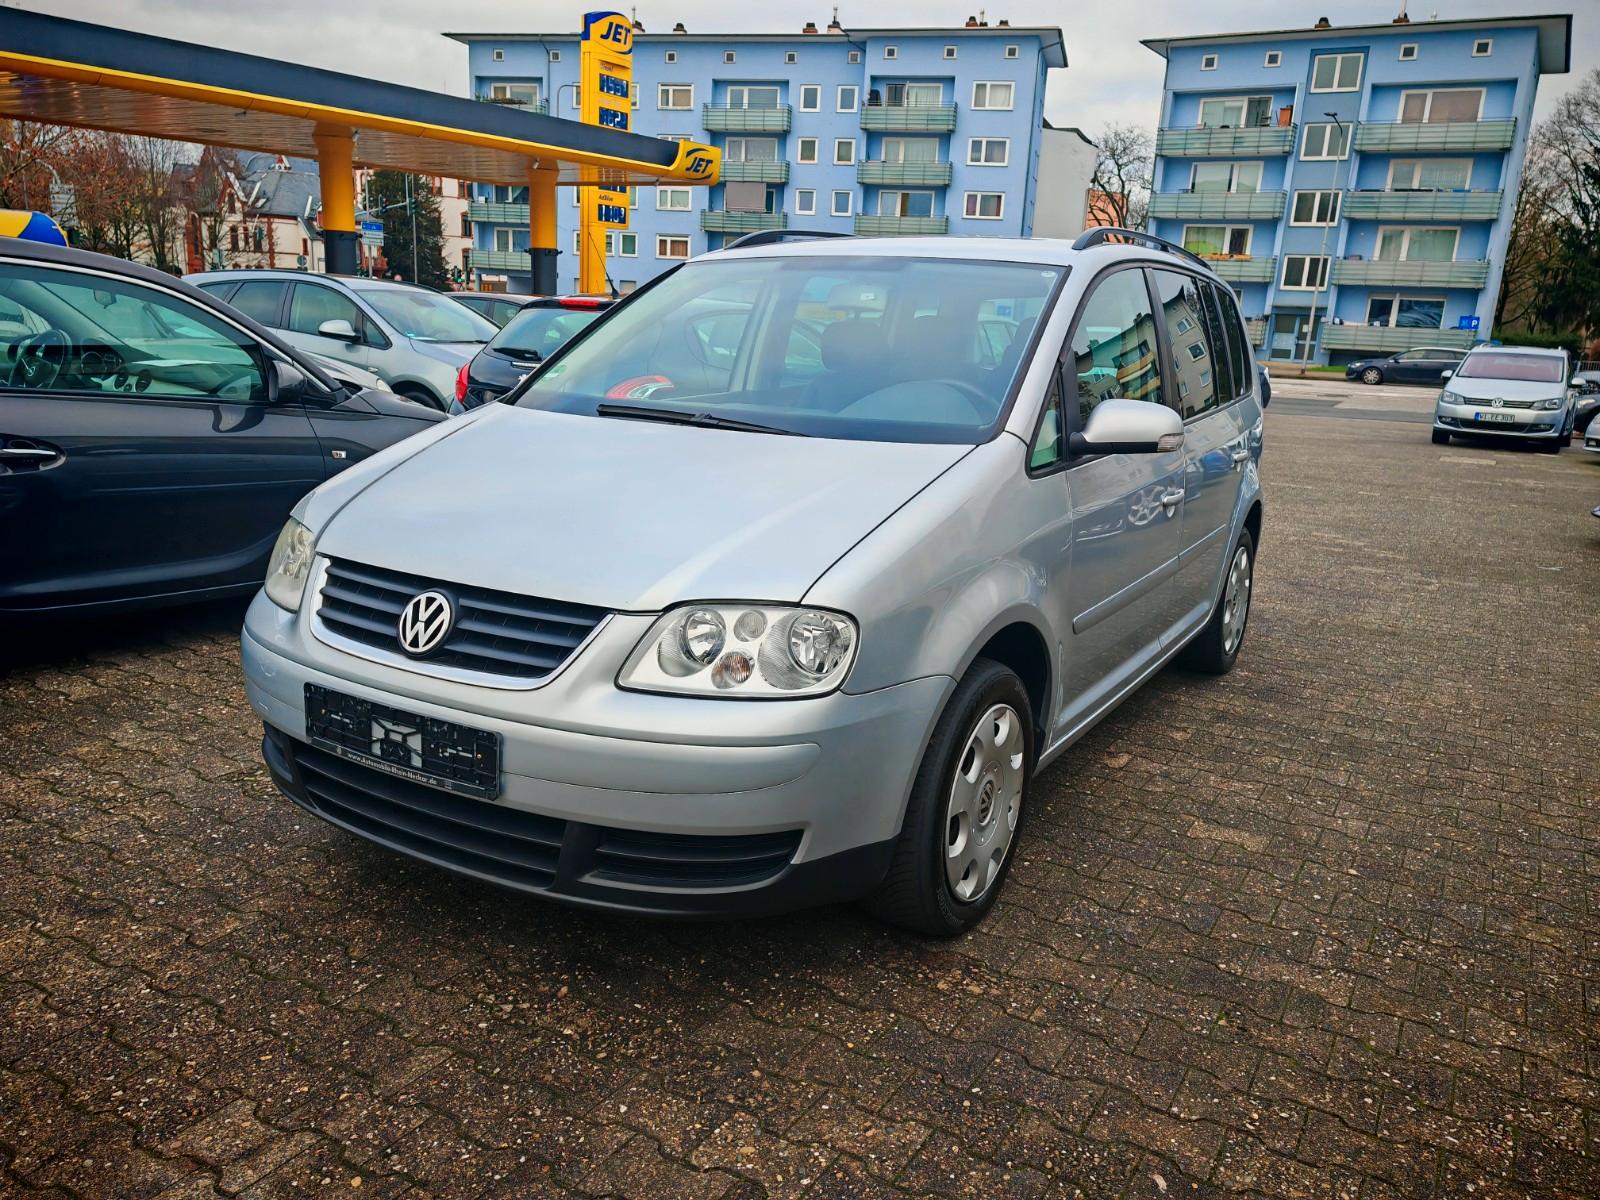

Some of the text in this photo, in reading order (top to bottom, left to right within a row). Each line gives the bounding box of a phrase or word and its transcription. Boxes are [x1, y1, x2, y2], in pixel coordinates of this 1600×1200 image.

[600, 21, 631, 45] JET
[685, 157, 713, 174] JET
[1471, 319, 1478, 328] P
[400, 592, 450, 652] VW
